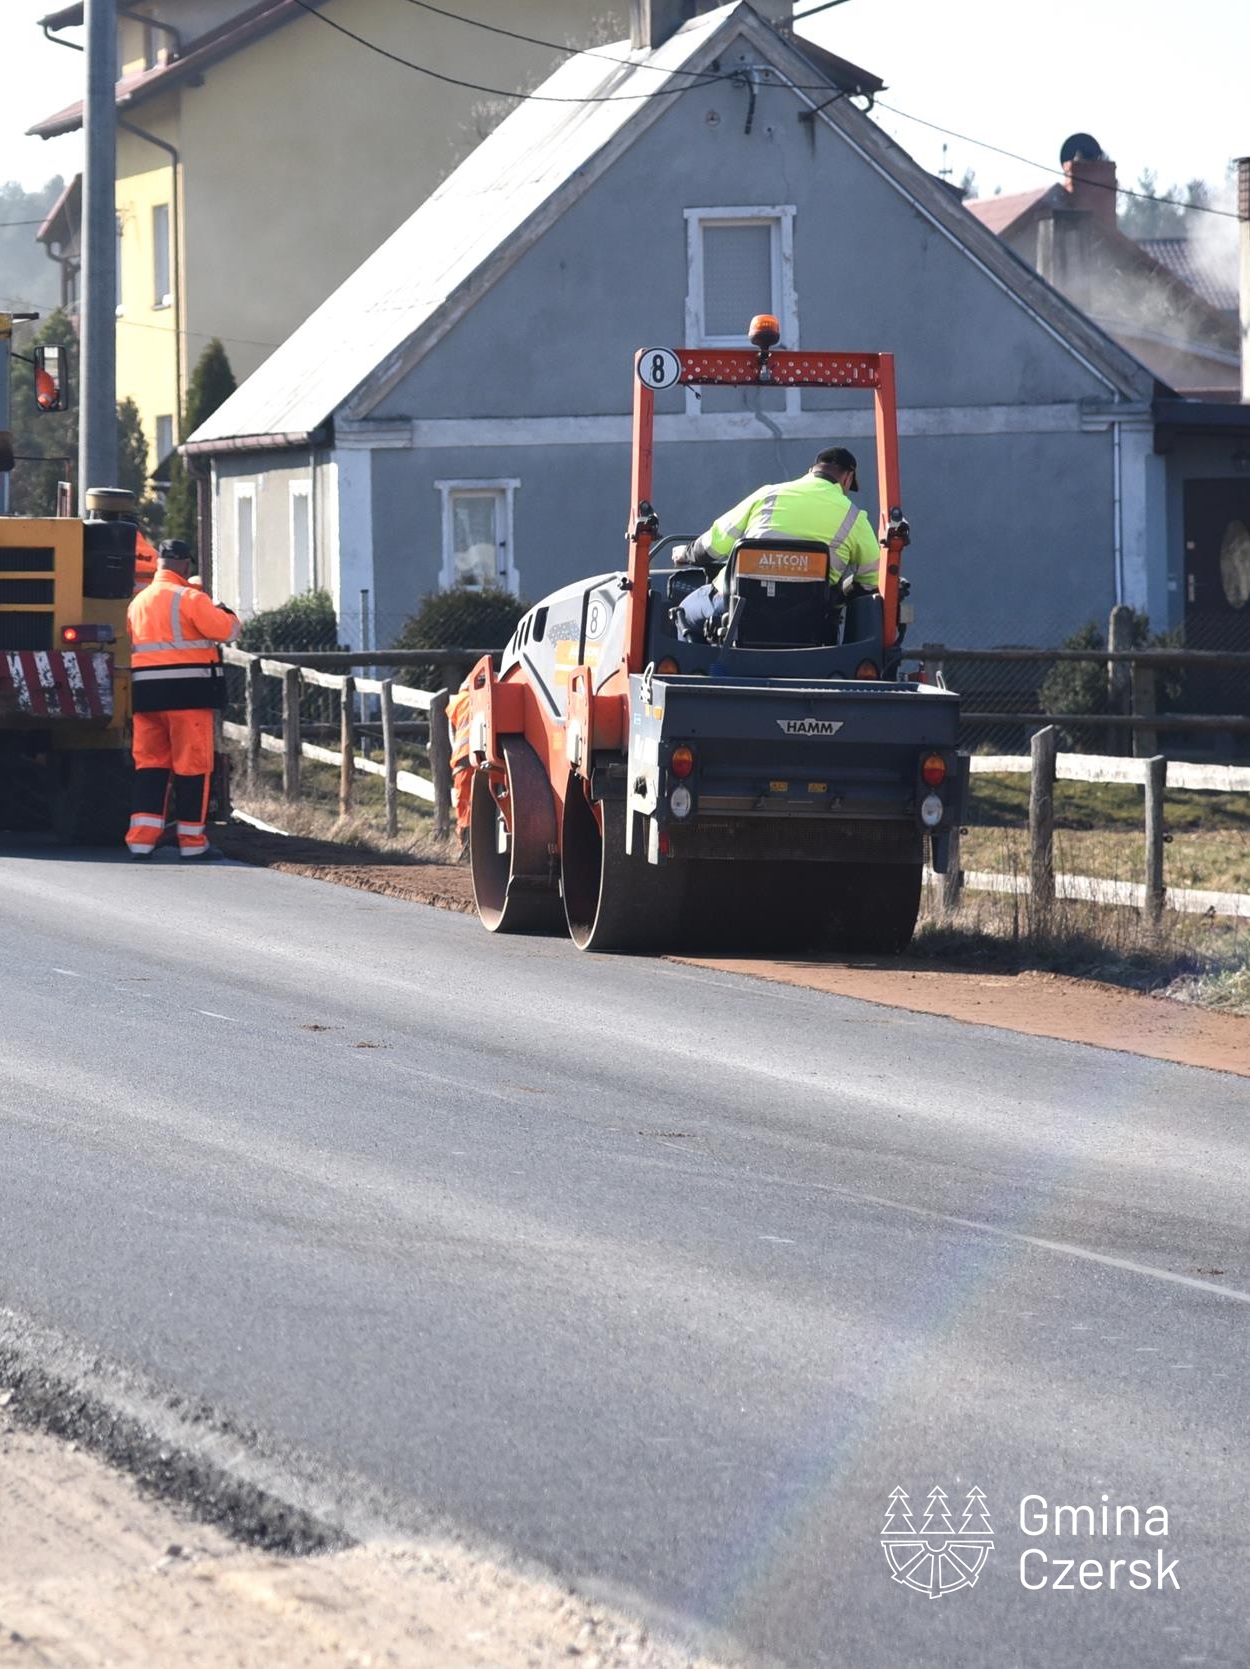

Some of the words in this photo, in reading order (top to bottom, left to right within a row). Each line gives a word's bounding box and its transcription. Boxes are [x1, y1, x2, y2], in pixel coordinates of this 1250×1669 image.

[652, 354, 665, 383] 8
[137, 553, 152, 562] bd
[759, 553, 808, 567] ALTCON
[590, 606, 599, 634] 8
[787, 721, 833, 734] HAMM
